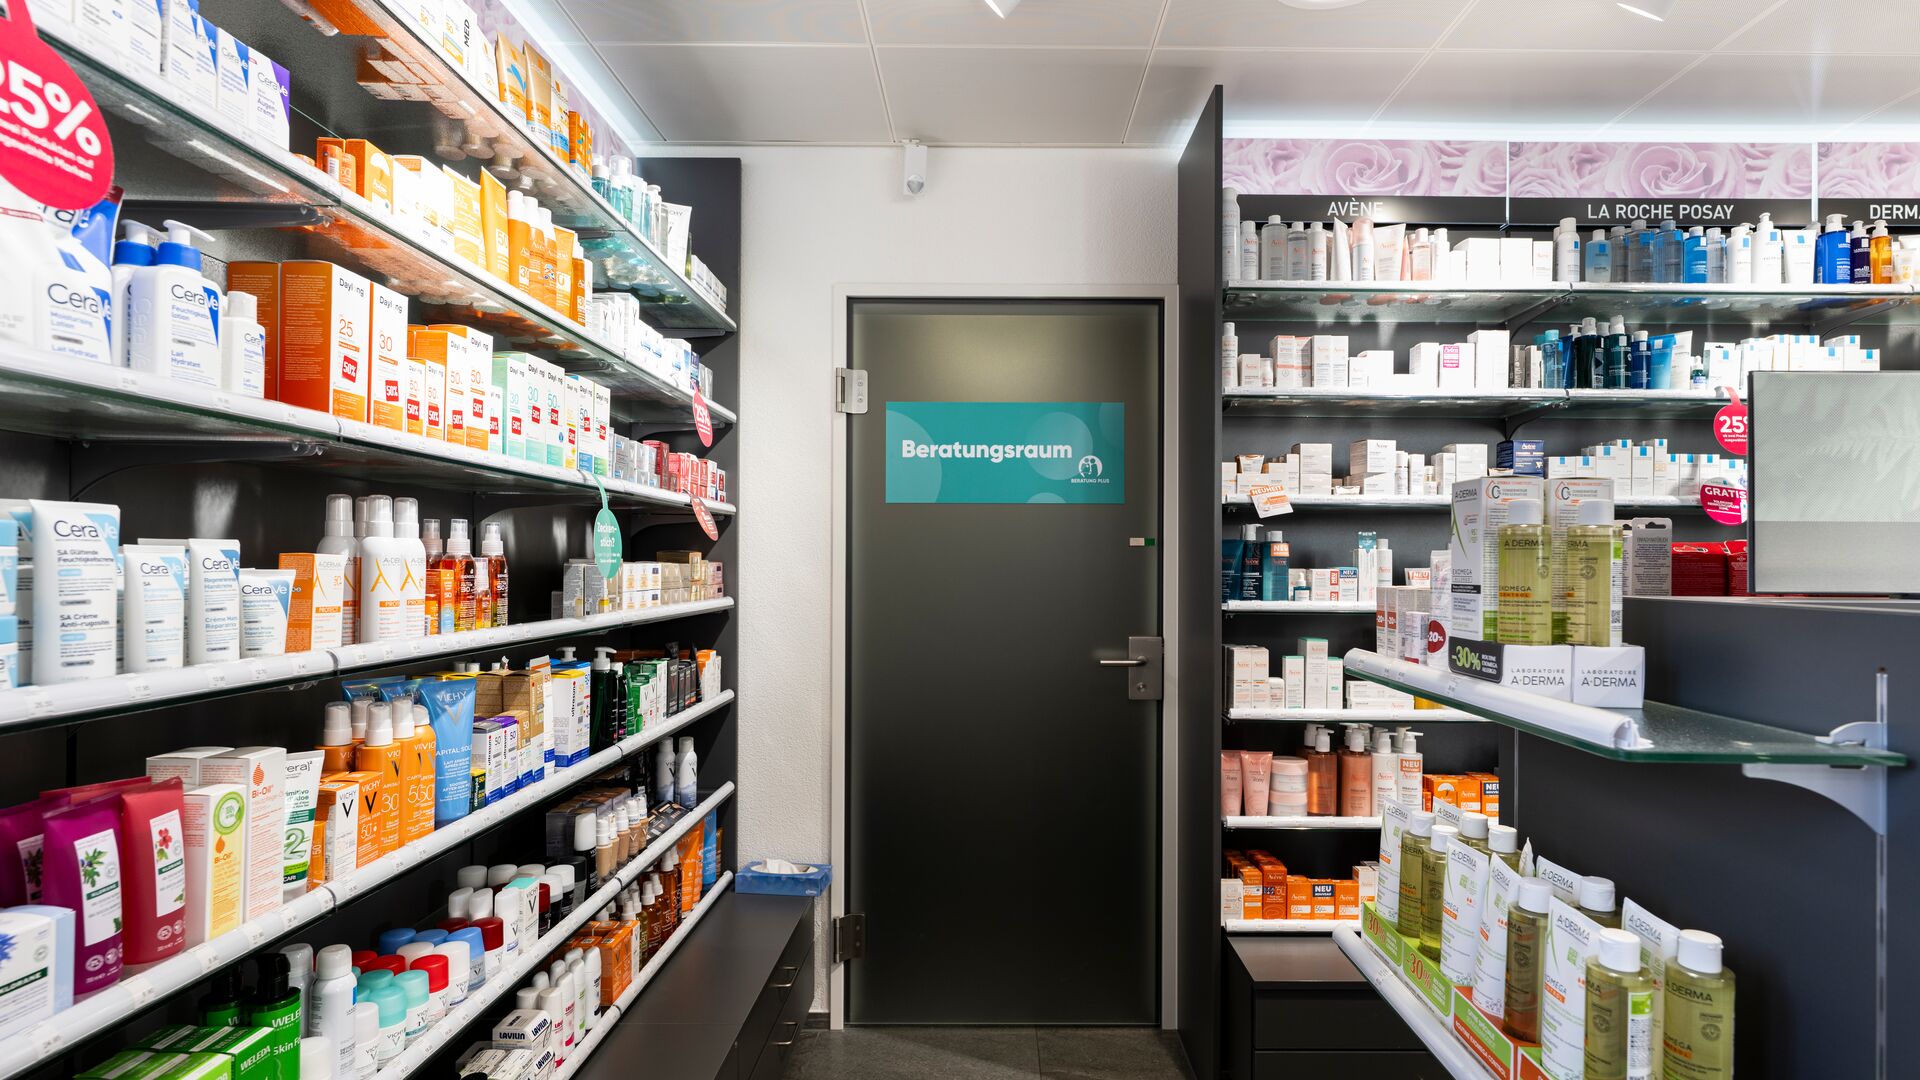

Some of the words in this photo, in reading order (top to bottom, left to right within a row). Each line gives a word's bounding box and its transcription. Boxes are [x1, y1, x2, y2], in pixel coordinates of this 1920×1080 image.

[221, 47, 248, 69] CeraVe
[258, 72, 288, 97] CeraVe
[0, 60, 101, 156] 5%
[1327, 197, 1383, 216] AVÈNE
[1587, 204, 1610, 219] LA
[1615, 204, 1673, 220] ROCHE
[1679, 204, 1734, 220] POSAY
[1870, 204, 1920, 220] DERM
[171, 284, 219, 310] CeraVe
[339, 318, 354, 338] 25
[379, 333, 393, 352] 30
[342, 363, 357, 379] 50%
[386, 384, 399, 398] 50%
[528, 386, 539, 402] 30
[407, 404, 419, 416] 50%
[428, 410, 439, 421] 50%
[473, 403, 483, 414] 50%
[452, 414, 463, 425] 50%
[902, 440, 1072, 463] Beratungsraum
[1252, 485, 1282, 495] NEUHEIT
[1705, 487, 1747, 499] GRATIS
[54, 520, 118, 538] CeraVe
[140, 562, 183, 575] CeraVe
[202, 557, 240, 570] CeraVe
[1452, 568, 1472, 576] EXOMEGA
[241, 585, 288, 595] CeraVe
[1452, 645, 1481, 671] -30%
[437, 690, 467, 702] VICHY
[523, 720, 530, 731] 50
[494, 735, 501, 746] 50
[510, 730, 516, 740] 50
[387, 750, 400, 758] VIC
[340, 789, 357, 800] VICHY
[361, 780, 381, 793] VICHY
[382, 793, 400, 813] 30
[1407, 953, 1432, 990] -30%
[271, 1007, 301, 1029] WELE
[531, 1018, 549, 1037] LAVILIN
[499, 1032, 526, 1040] LAVILIN
[273, 1040, 294, 1056] Skin
[240, 1045, 271, 1071] WELEDA
[535, 1051, 552, 1070] LAVILIN
